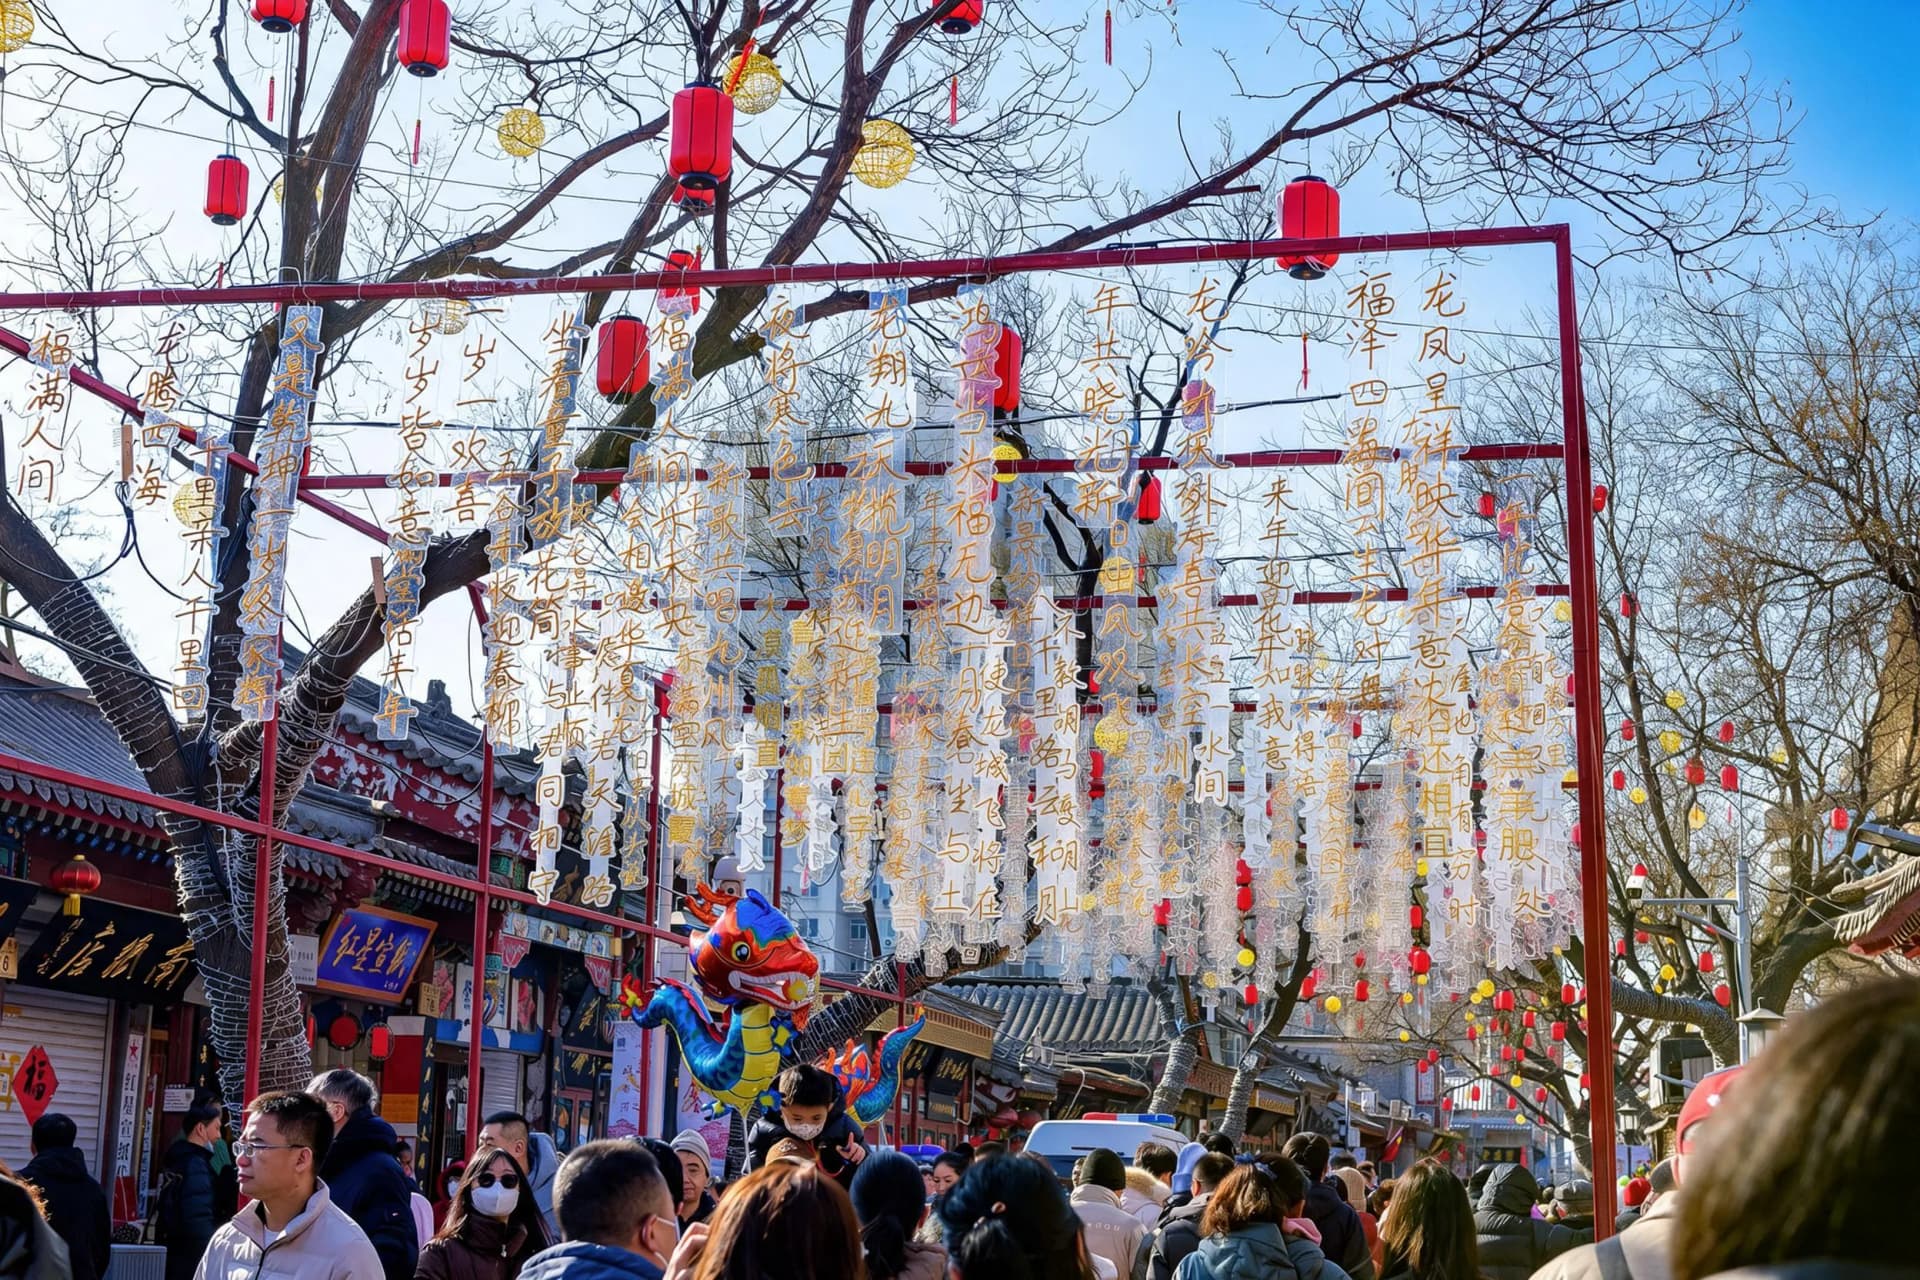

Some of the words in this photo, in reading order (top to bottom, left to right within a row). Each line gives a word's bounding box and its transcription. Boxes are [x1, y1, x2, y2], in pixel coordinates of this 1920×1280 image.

[18, 323, 72, 503] 福满人间
[134, 321, 193, 506] 龙腾四海
[443, 309, 504, 523] 一岁一欢喜
[527, 310, 587, 640] 坐看童子放花筒
[652, 309, 699, 639] 福满人间乐未央
[760, 295, 815, 531] 夜将寒色去
[861, 294, 911, 630] 龙翔九天揽明月
[946, 295, 1012, 635] 鸿运当头福无边
[1075, 284, 1135, 521] 年共晓光新
[1404, 271, 1466, 628] 龙凤呈祥映华年
[173, 439, 231, 709] 千里亲人千里回
[23, 1055, 46, 1100] 福
